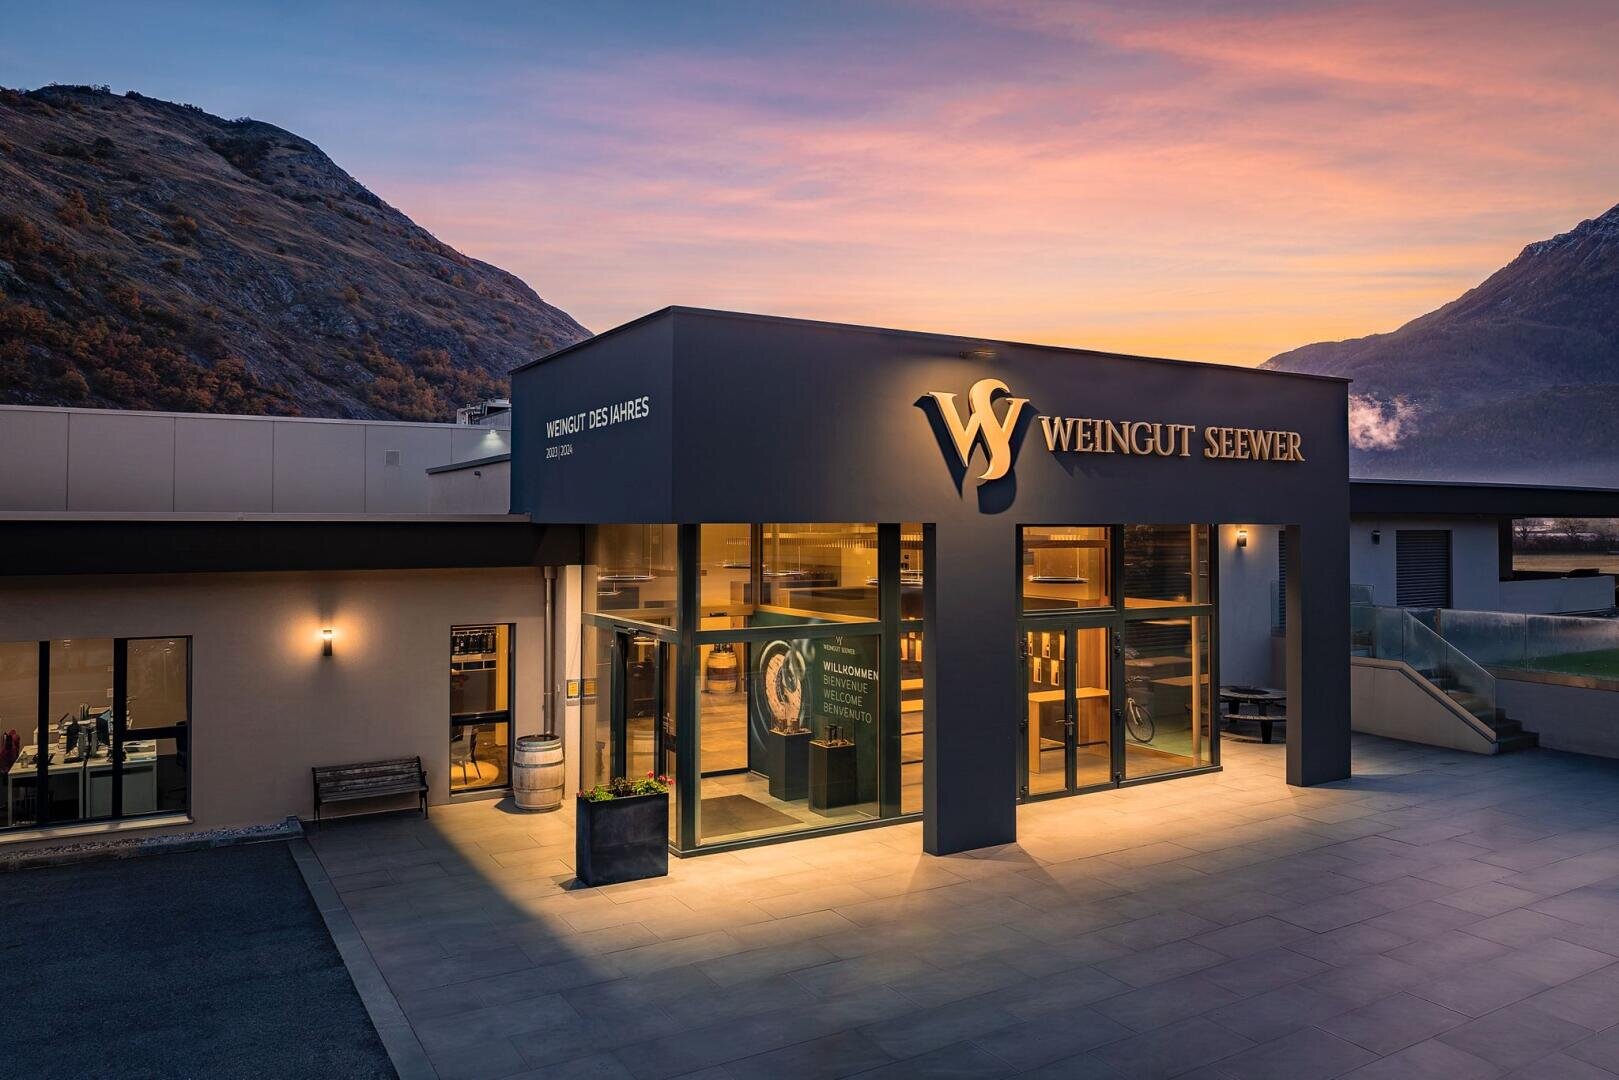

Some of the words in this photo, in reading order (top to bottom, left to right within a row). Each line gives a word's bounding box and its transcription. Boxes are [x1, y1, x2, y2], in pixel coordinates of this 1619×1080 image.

[546, 412, 586, 439] WEINGUT
[588, 407, 608, 430] DES
[609, 396, 650, 425] JAHRES
[1037, 415, 1196, 457] WEINGUT
[1203, 426, 1305, 462] SEEWER
[823, 661, 879, 680] WILLKOMMEN
[823, 674, 868, 693] BIENVENUE
[823, 688, 863, 707] WELCOME
[823, 702, 872, 723] BENVENUTO
